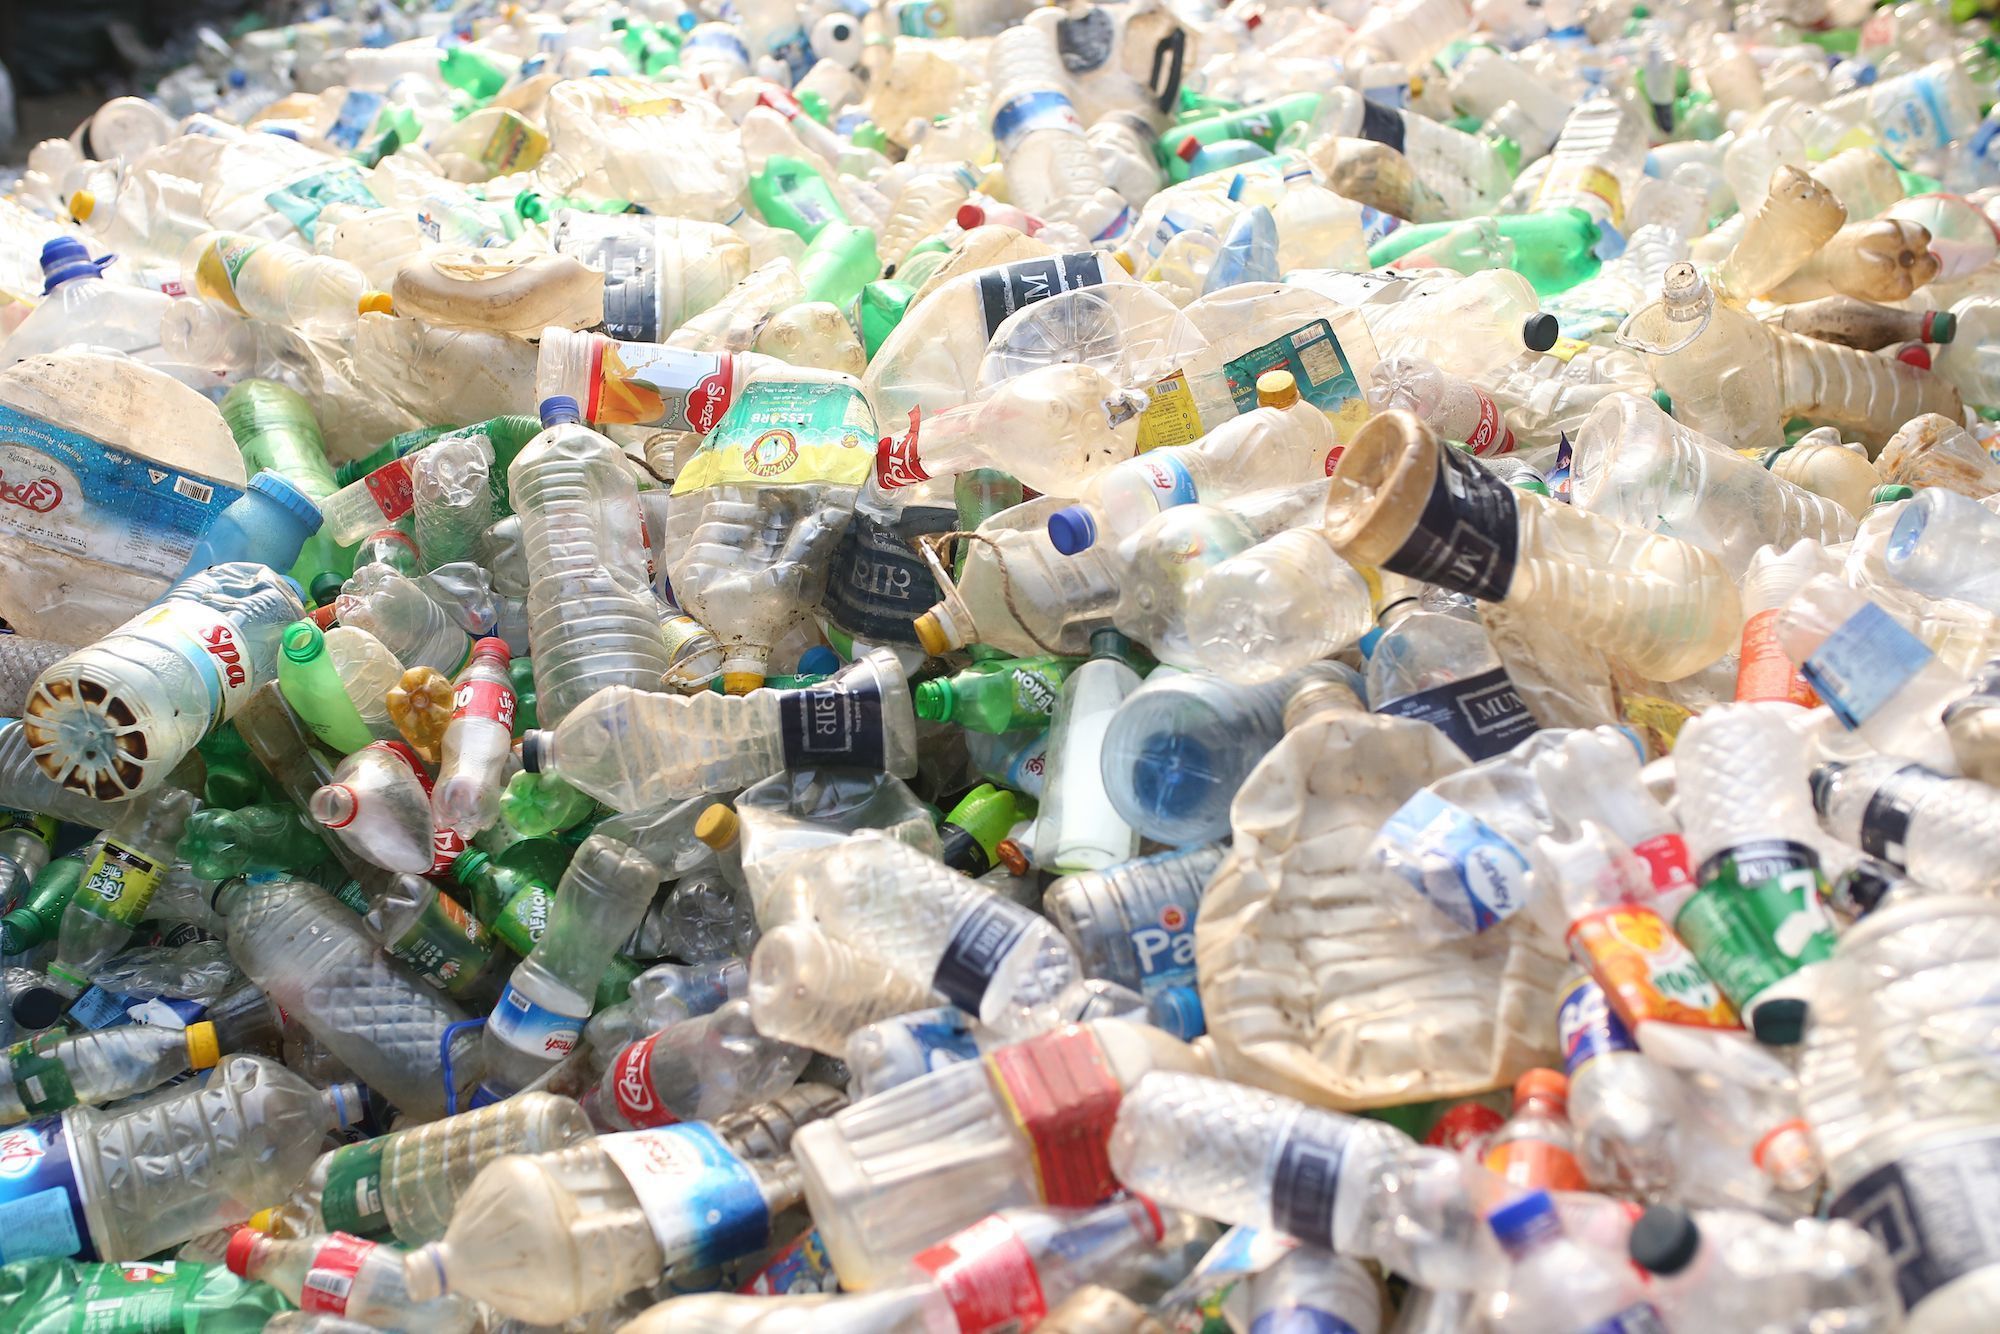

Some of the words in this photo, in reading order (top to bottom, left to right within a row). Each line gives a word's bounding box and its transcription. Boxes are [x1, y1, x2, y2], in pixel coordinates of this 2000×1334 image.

[744, 452, 797, 476] RUPCHANDA
[198, 624, 246, 689] Spa
[529, 886, 548, 944] CLEMON
